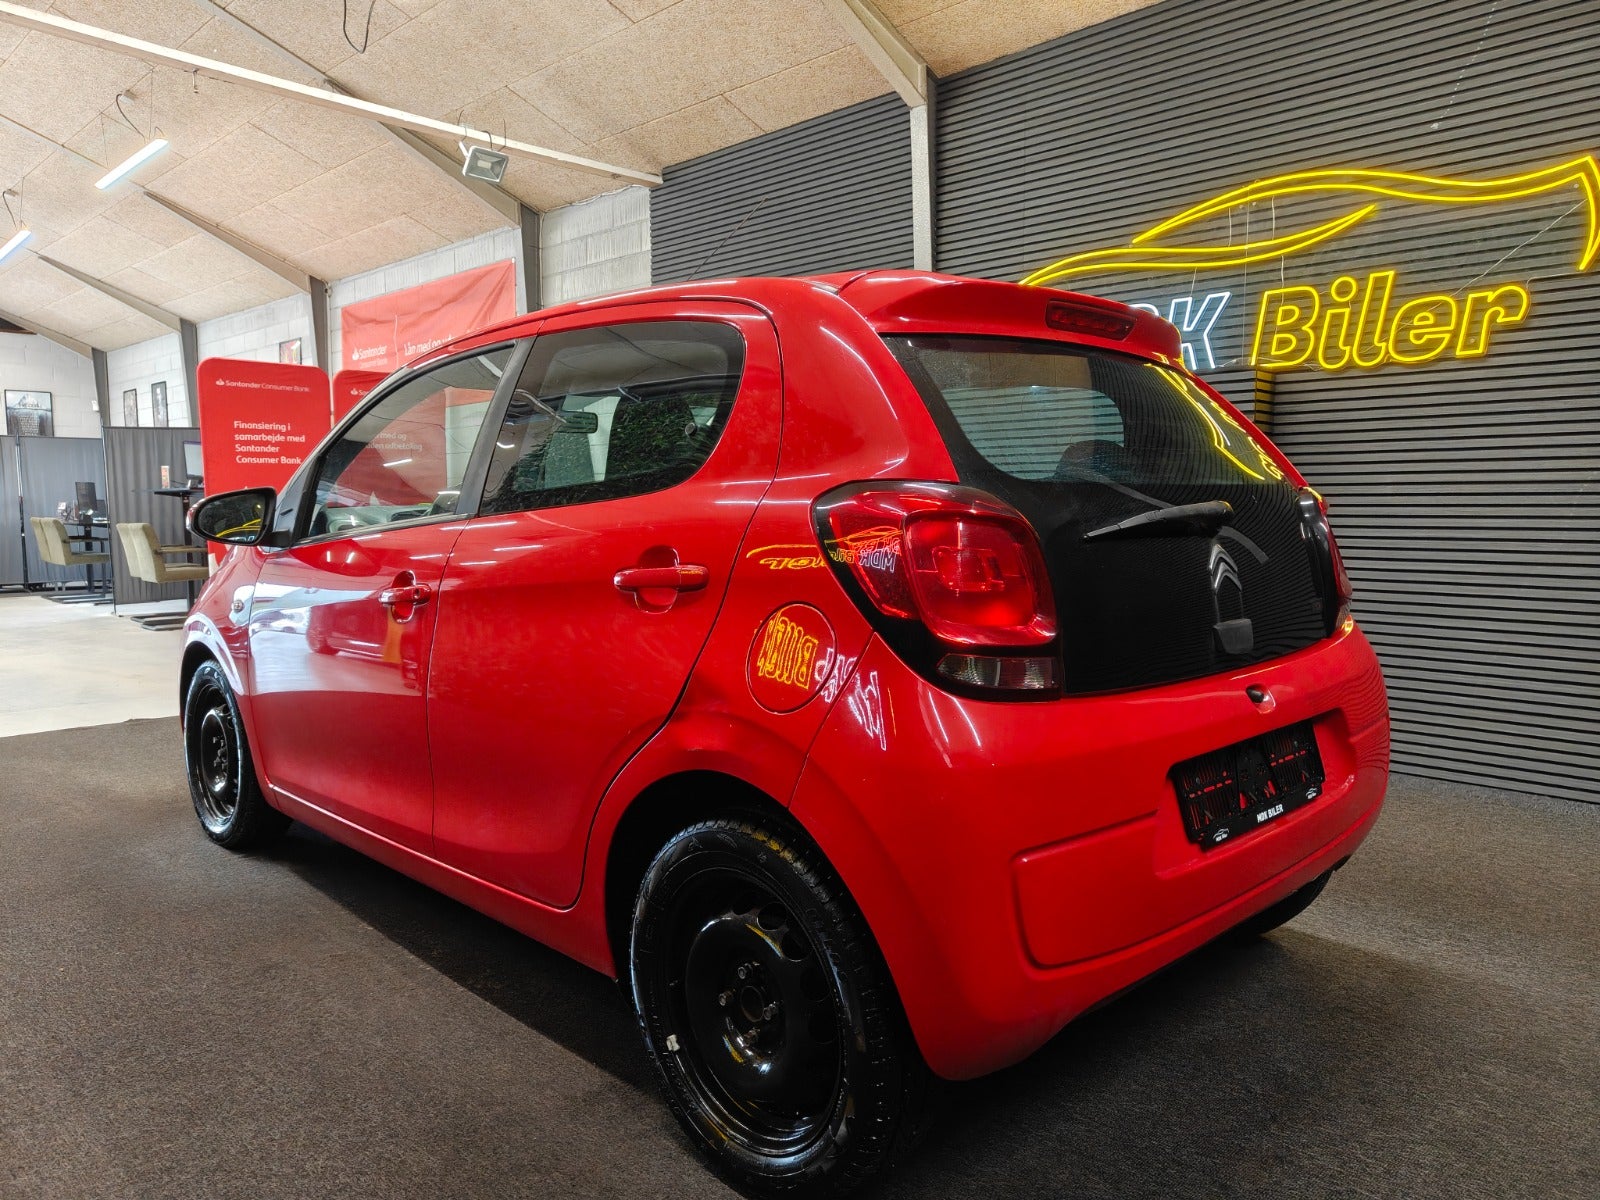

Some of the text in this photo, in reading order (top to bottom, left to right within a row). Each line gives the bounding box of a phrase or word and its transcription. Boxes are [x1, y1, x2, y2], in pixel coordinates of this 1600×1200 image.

[1250, 270, 1529, 370] Biler
[225, 380, 261, 389] Santander
[261, 383, 293, 391] Consumer
[233, 420, 291, 432] Finansiering i
[234, 433, 305, 443] samarbejde med
[235, 444, 280, 453] Santander
[236, 455, 302, 465] Consumer Bank
[1268, 804, 1284, 818] BILER
